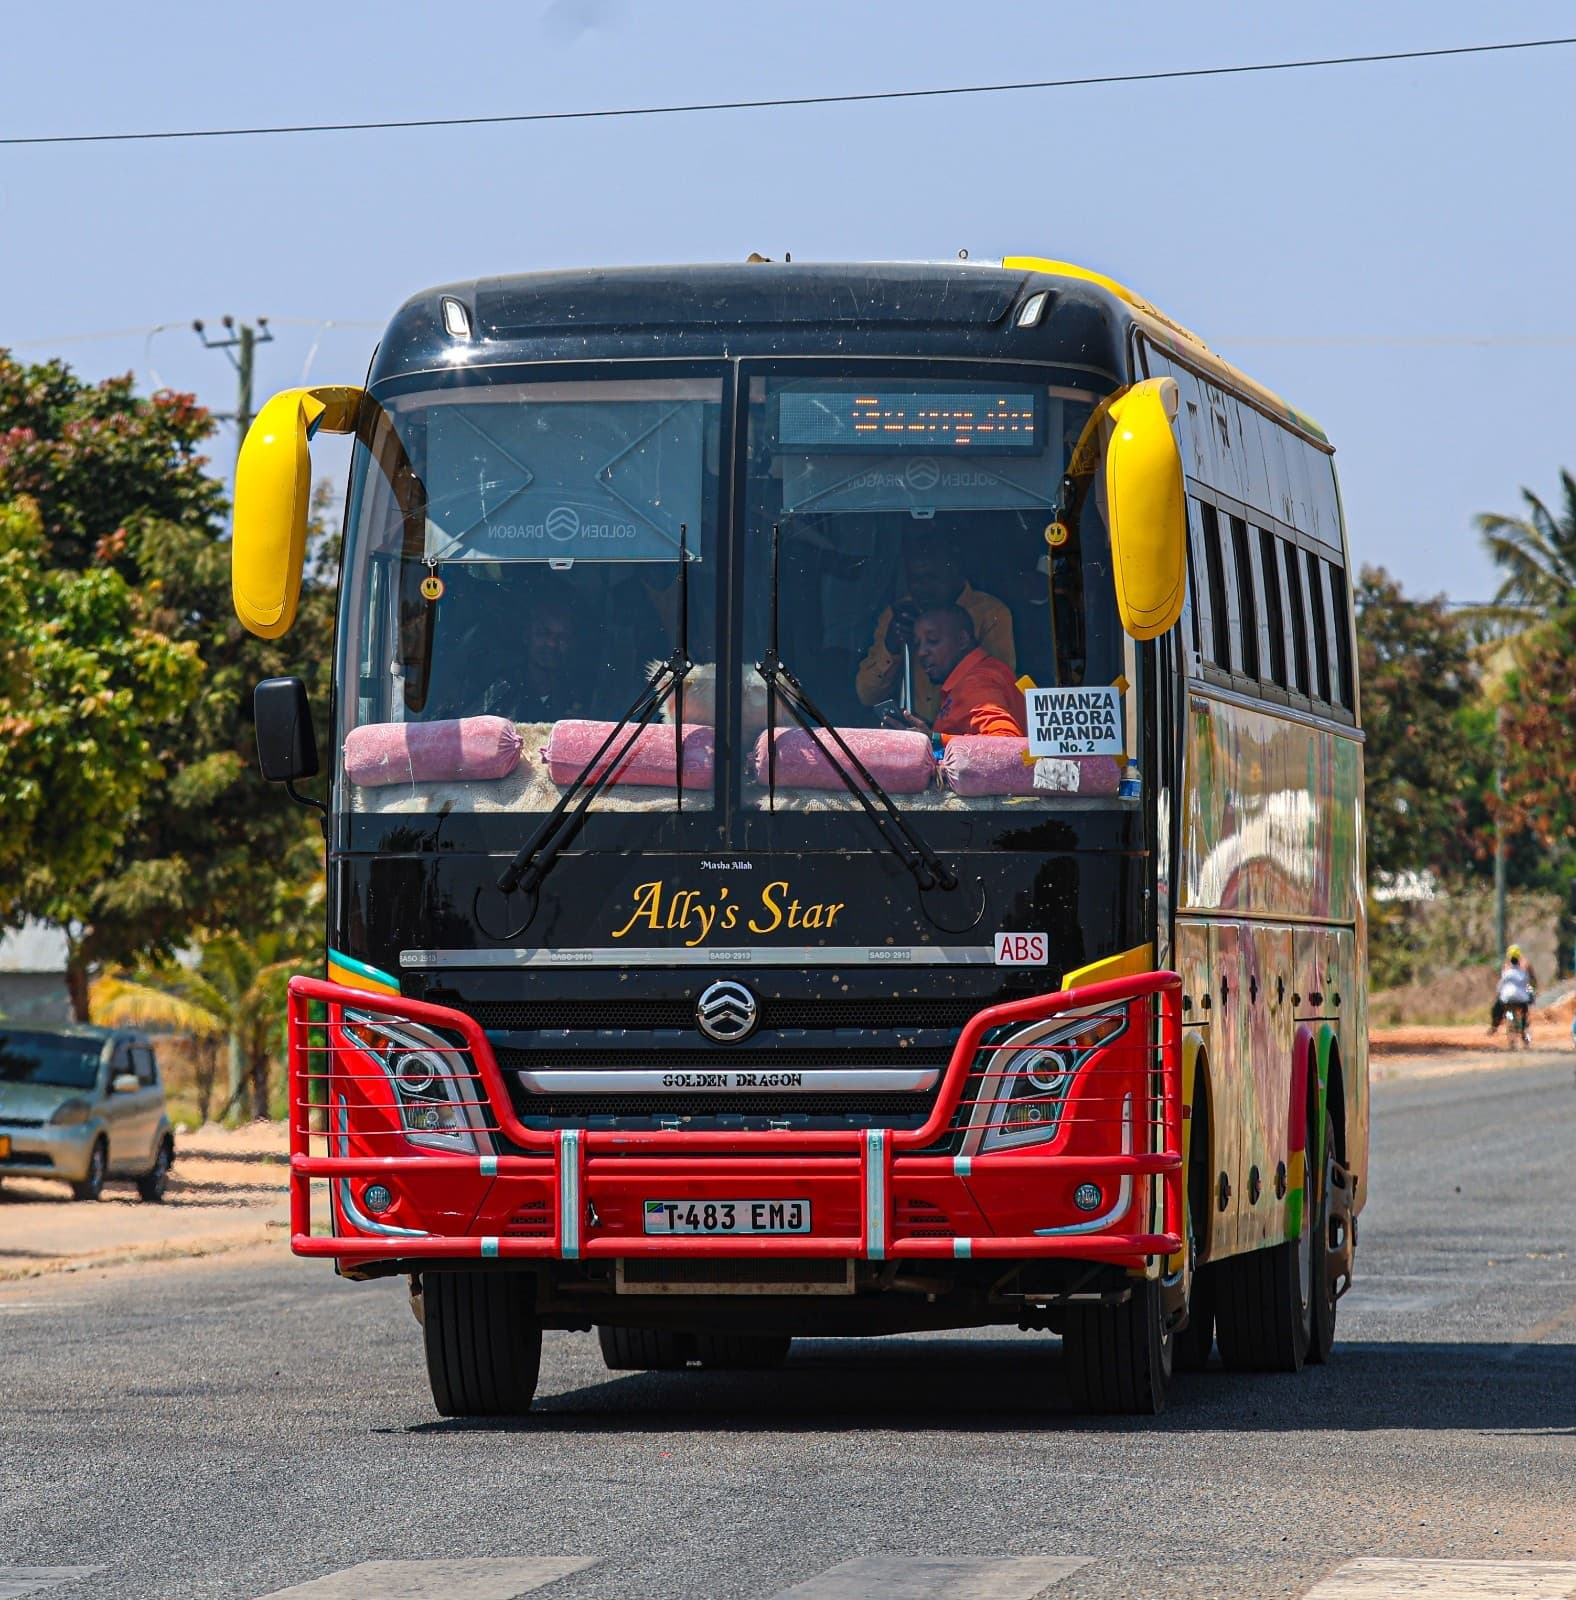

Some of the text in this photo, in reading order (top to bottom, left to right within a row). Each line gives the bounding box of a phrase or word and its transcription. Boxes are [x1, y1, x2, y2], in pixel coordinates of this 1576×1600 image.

[1034, 693, 1115, 711] MWANZA
[1035, 710, 1115, 726] TABORA
[1036, 726, 1116, 741] MPANDA
[1059, 740, 1095, 753] No. 2
[700, 860, 752, 870] Masha Allah
[611, 880, 845, 947] Ally's Star
[1000, 936, 1044, 961] ABS
[663, 1073, 802, 1087] GOLDEN DRAGON
[751, 1203, 803, 1230] EMJ
